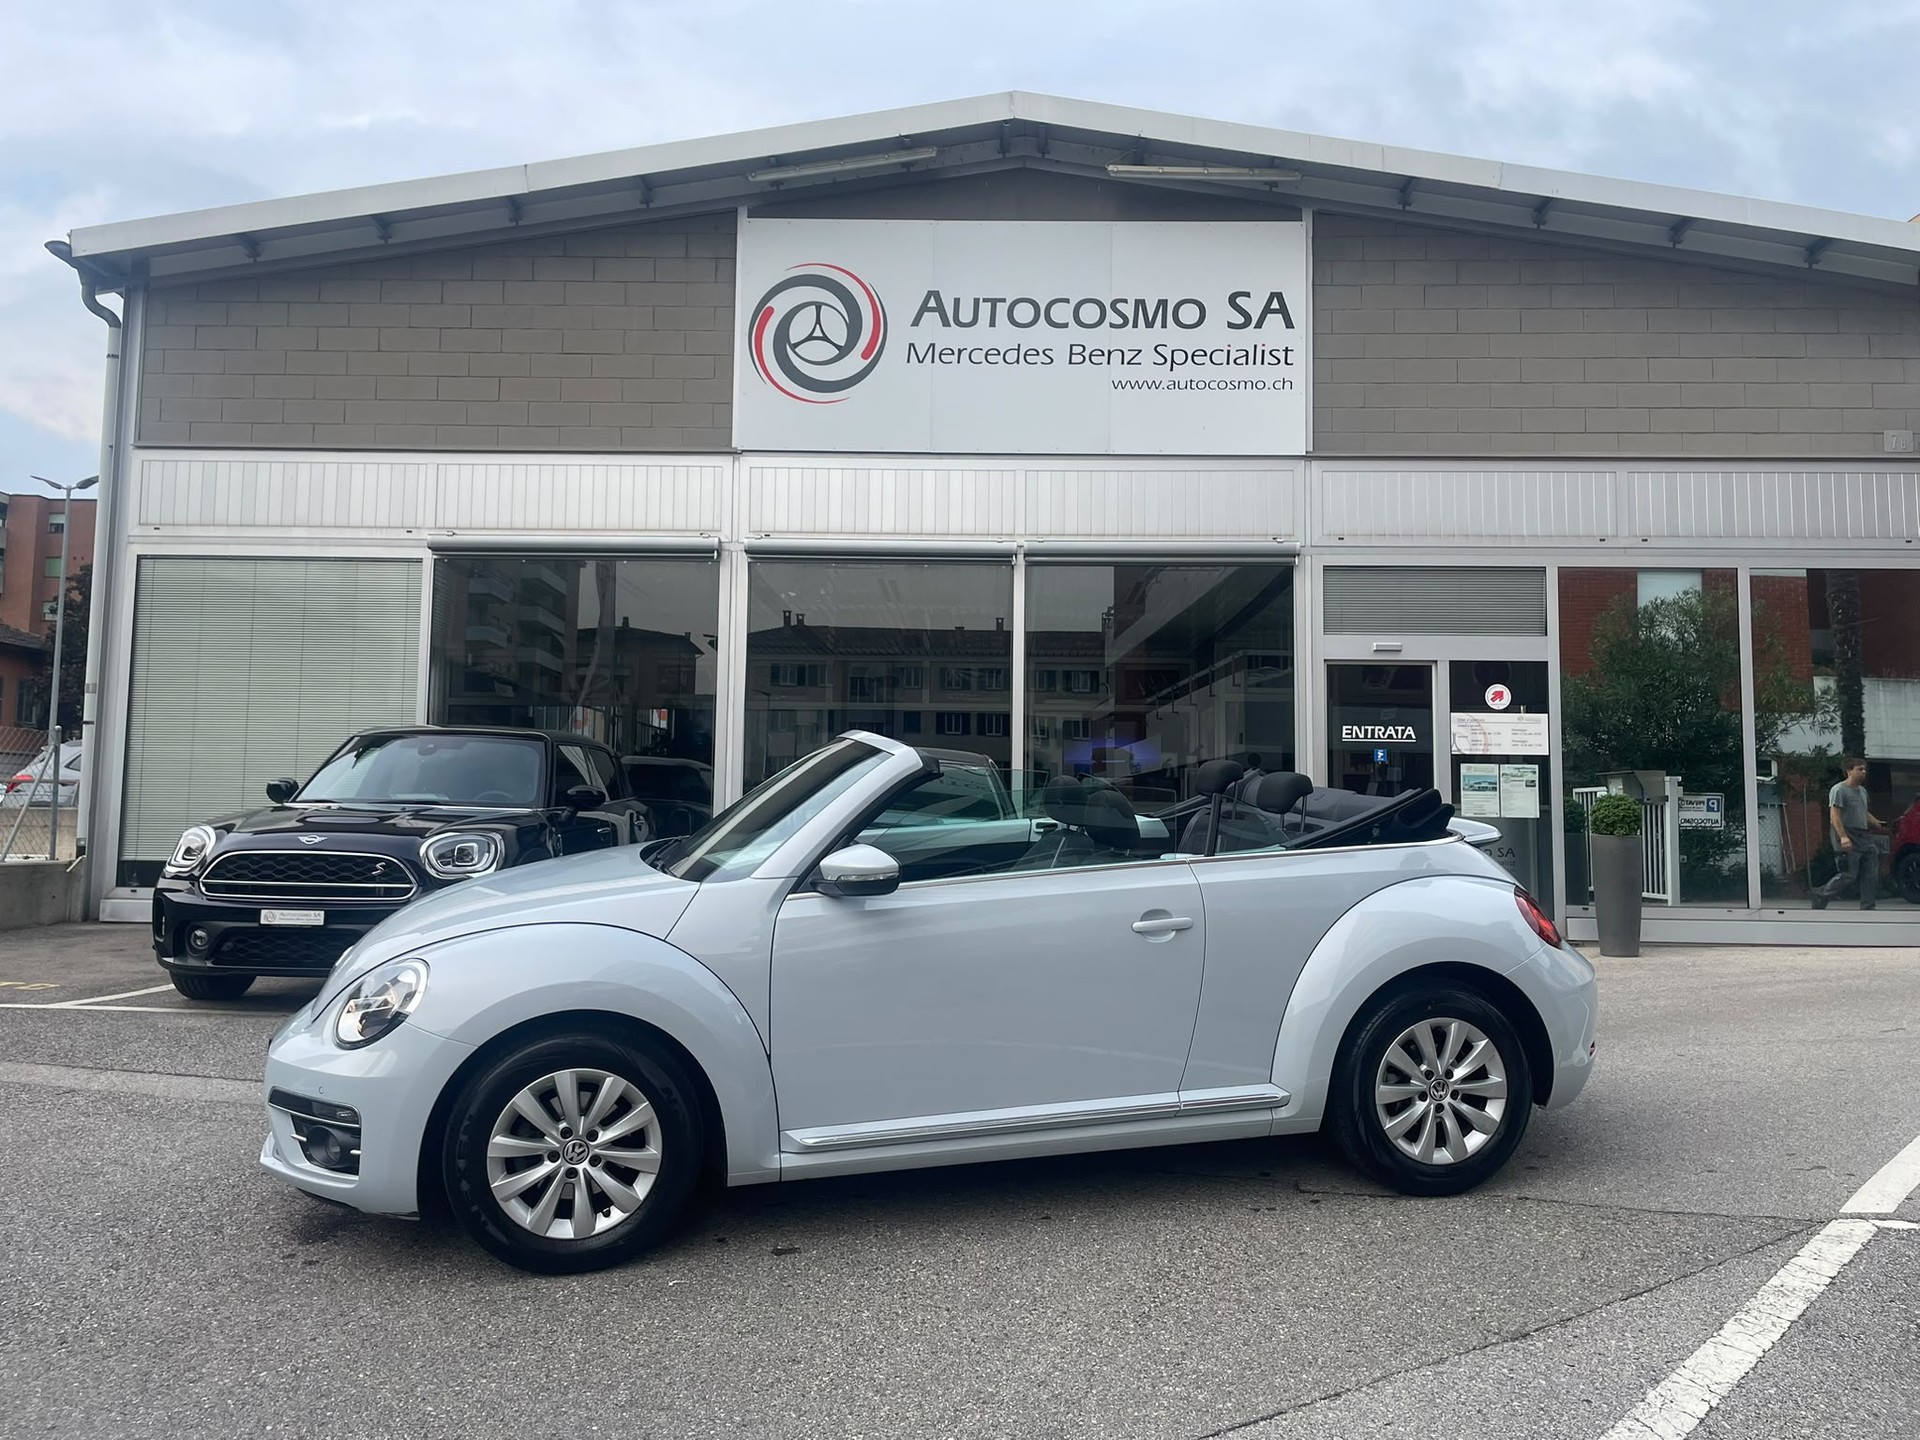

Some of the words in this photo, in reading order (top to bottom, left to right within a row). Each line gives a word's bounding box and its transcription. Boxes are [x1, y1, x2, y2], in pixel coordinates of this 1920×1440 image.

[911, 290, 1206, 329] AUTOCOSMO
[1227, 291, 1295, 329] SA
[906, 343, 1054, 366] Mercedes
[1068, 344, 1143, 366] Benz
[1153, 343, 1295, 371] Specialist
[1111, 377, 1293, 391] www.autocosmo.ch
[1342, 726, 1416, 739] ENTRATA
